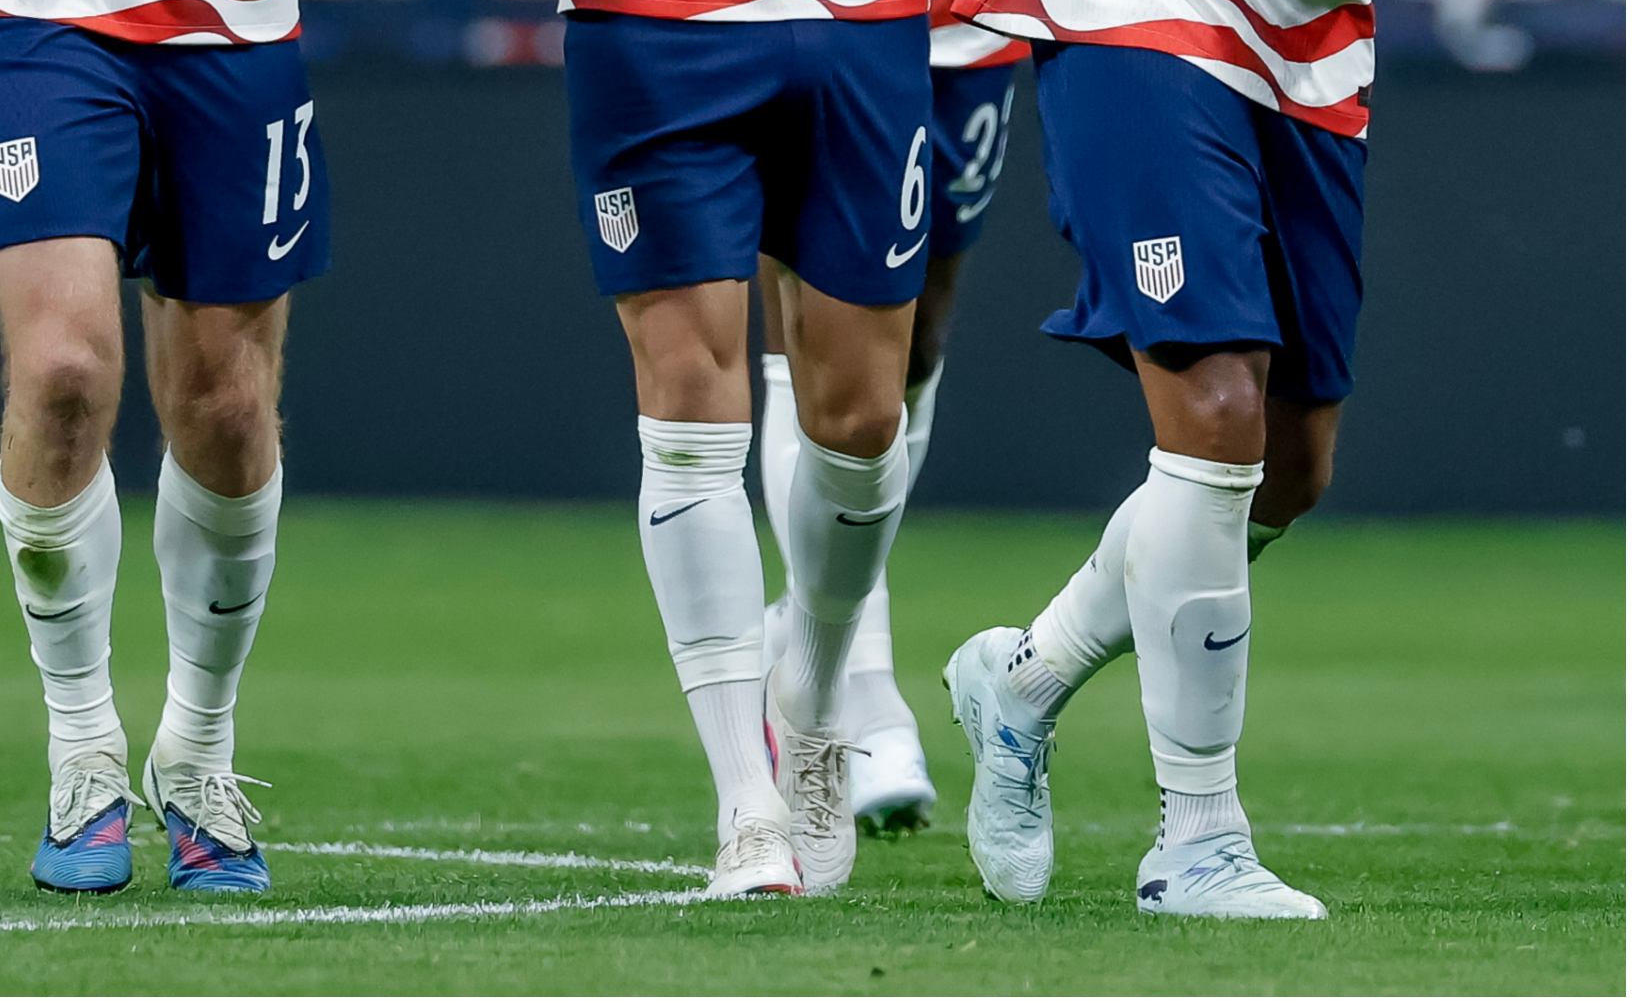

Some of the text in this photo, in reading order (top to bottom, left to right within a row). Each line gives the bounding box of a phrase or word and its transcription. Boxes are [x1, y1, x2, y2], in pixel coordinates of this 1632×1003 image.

[263, 99, 314, 225] 13
[900, 125, 926, 230] 6
[598, 191, 631, 217] USA
[1137, 240, 1178, 267] USA
